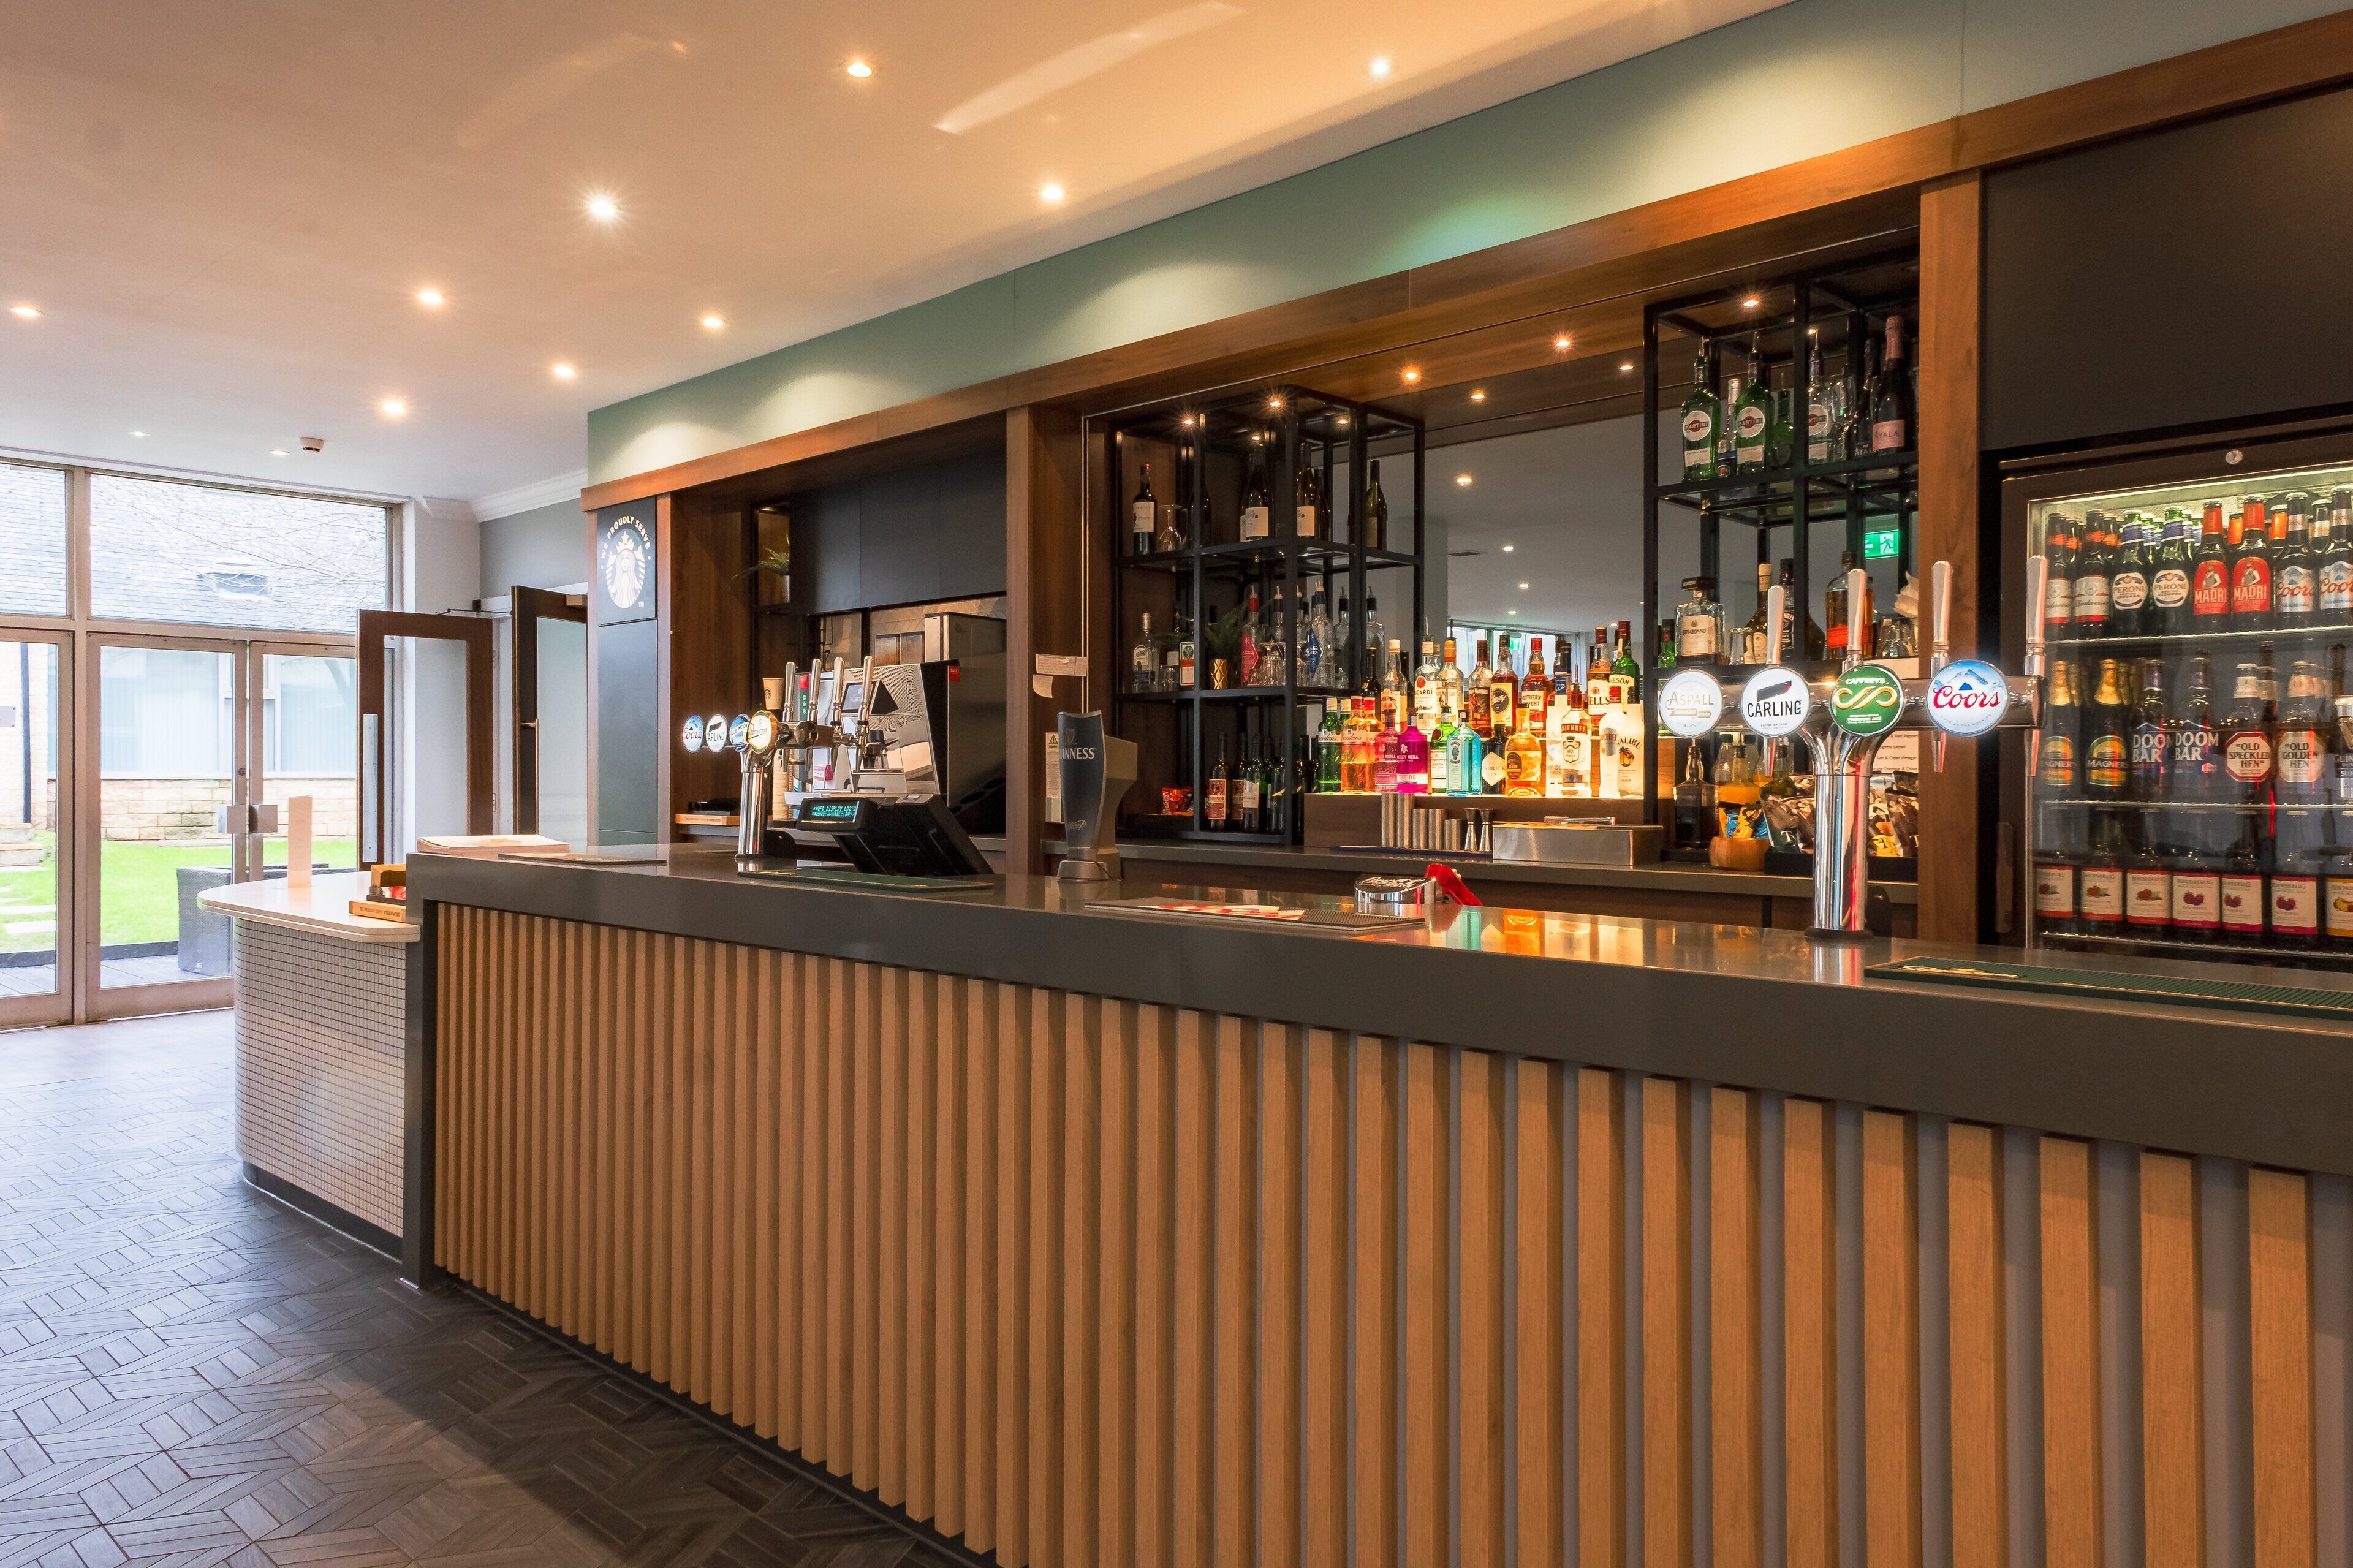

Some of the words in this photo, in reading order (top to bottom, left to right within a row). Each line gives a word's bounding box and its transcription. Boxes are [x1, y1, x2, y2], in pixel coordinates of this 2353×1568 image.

[1738, 418, 1762, 426] MARTINI
[1875, 430, 1898, 439] AYALA
[1854, 447, 1869, 457] AYA
[601, 542, 608, 559] WE
[607, 515, 635, 540] PROUDLY
[635, 520, 651, 550] SERVE
[1590, 697, 1610, 705] ELL'S
[1665, 691, 1714, 710] ASPALL
[1933, 685, 2000, 709] Coors
[1747, 700, 1802, 718] CARLING
[2133, 733, 2172, 748] DOOM
[2175, 731, 2219, 746] DOOM
[1059, 748, 1096, 759] UINNESS
[2132, 748, 2162, 763] BAR
[2175, 746, 2205, 761] BAR
[2229, 751, 2270, 760] SPECKLED
[2282, 751, 2318, 760] GOLDEN
